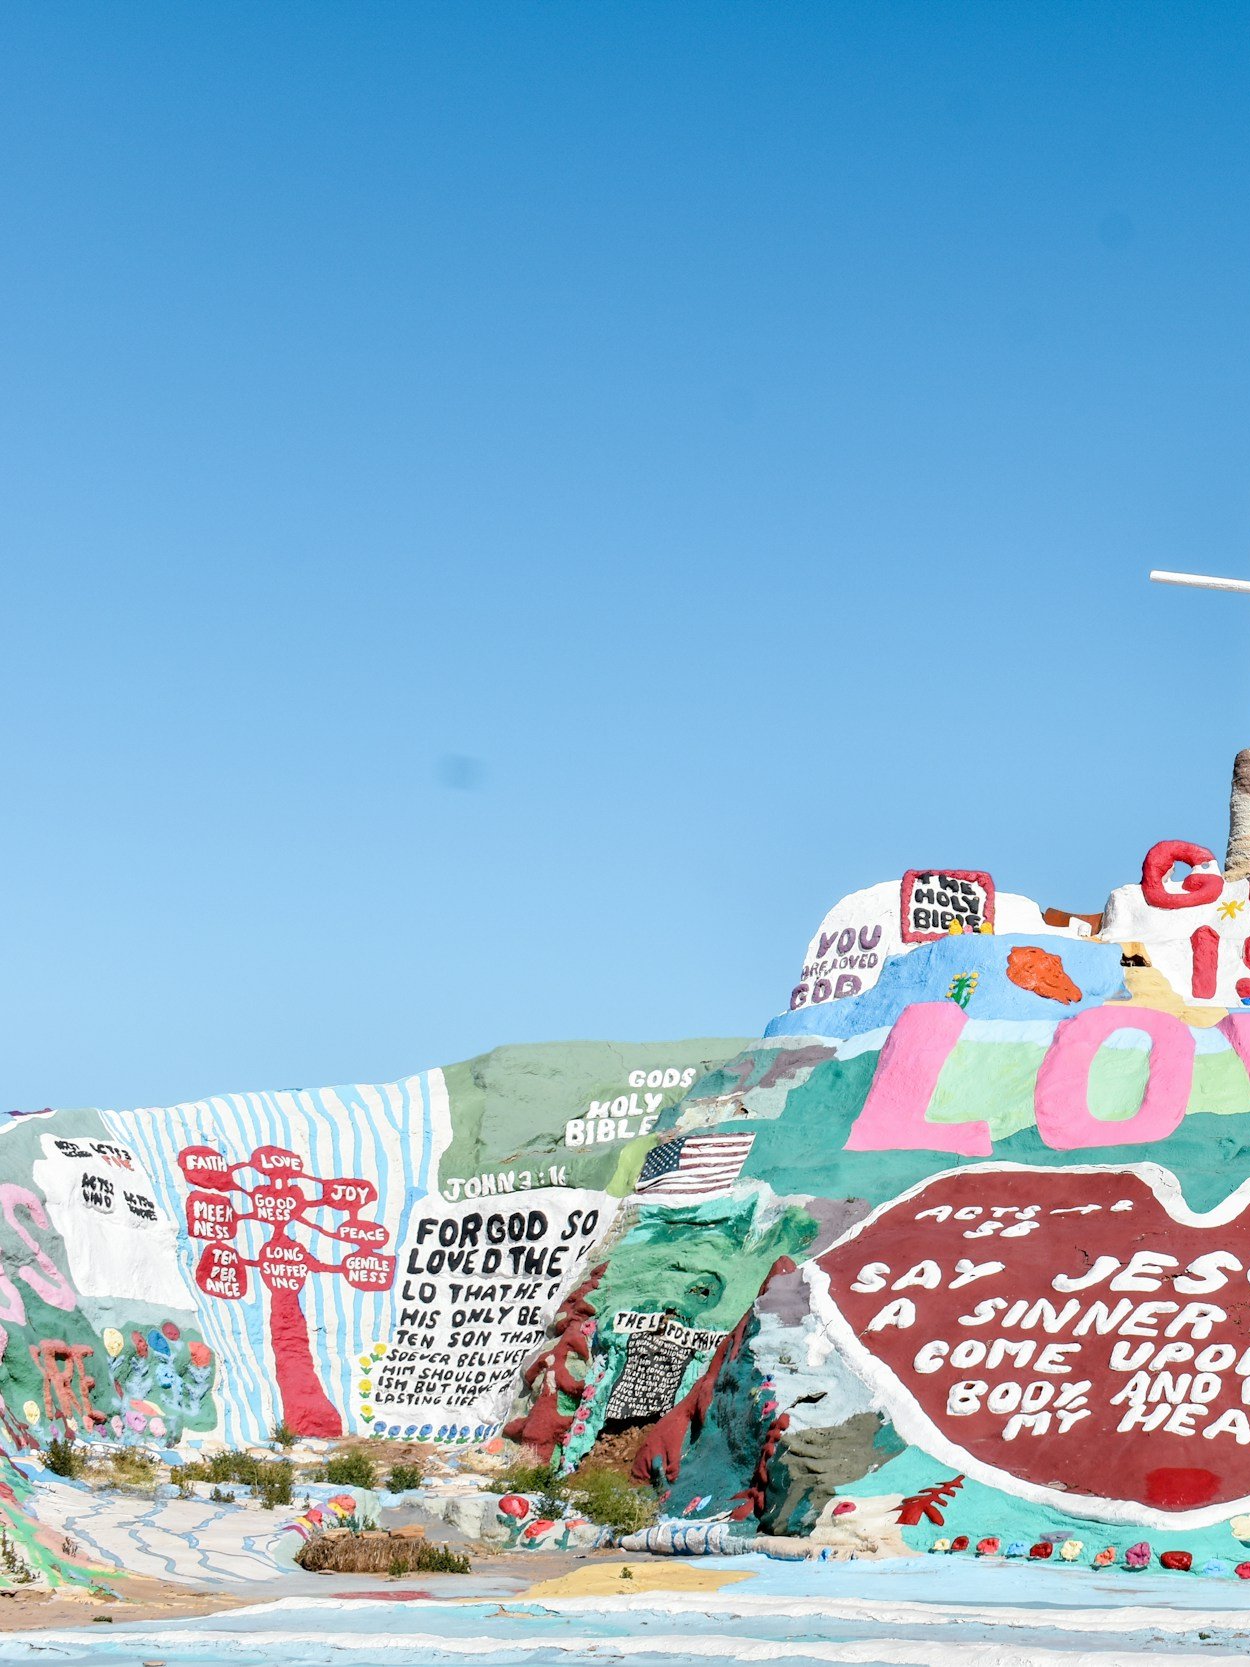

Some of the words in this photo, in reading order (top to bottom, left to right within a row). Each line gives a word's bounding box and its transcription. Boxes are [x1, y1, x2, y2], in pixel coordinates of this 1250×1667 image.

[917, 873, 976, 895] THE
[915, 889, 980, 914] HOLY
[816, 924, 882, 958] YOU
[832, 953, 878, 970] LOVED
[790, 974, 862, 1010] GOD
[628, 1067, 696, 1088] GODS
[587, 1093, 662, 1119] HOLY
[565, 1115, 659, 1147] BIBLE
[186, 1155, 227, 1172] FAITH
[261, 1154, 300, 1170] LOVE
[331, 1185, 369, 1204] JOY
[444, 1170, 514, 1200] JOHN
[255, 1194, 296, 1209] GOOD
[194, 1201, 233, 1222] MEEK
[258, 1208, 290, 1220] NESS
[915, 1203, 1042, 1223] ACTS
[194, 1223, 229, 1239] NESS
[339, 1227, 384, 1240] PEACE
[416, 1212, 483, 1248] FOR
[486, 1210, 548, 1244] GOD
[561, 1210, 598, 1241] SO
[212, 1249, 238, 1265] TEM
[266, 1247, 303, 1261] LONG
[407, 1248, 501, 1275] LOVED
[509, 1246, 569, 1277] THE
[263, 1262, 307, 1277] SUFFER
[346, 1257, 390, 1271] GENTLE
[211, 1267, 236, 1282] PER
[271, 1277, 299, 1289] ING
[349, 1271, 387, 1283] NESS
[850, 1258, 1005, 1293] SAY
[206, 1279, 240, 1297] ANCE
[448, 1284, 512, 1304] THAT
[513, 1282, 542, 1300] HE
[400, 1307, 441, 1329] HIS
[452, 1306, 514, 1327] ONLY
[617, 1313, 646, 1329] THE
[868, 1297, 917, 1333] A
[958, 1296, 1228, 1338] SINNER
[396, 1330, 435, 1349] TEN
[447, 1330, 492, 1348] SON
[386, 1349, 450, 1365] SOEVER
[913, 1338, 1083, 1374] COME
[382, 1365, 415, 1376] HIM
[419, 1368, 485, 1383] SHOULD
[414, 1380, 448, 1394] BUT
[946, 1378, 1094, 1416] BODY
[1109, 1371, 1220, 1406] AND
[375, 1392, 441, 1405] LASTING
[449, 1396, 478, 1406] LIFE
[1002, 1407, 1094, 1442] MY
